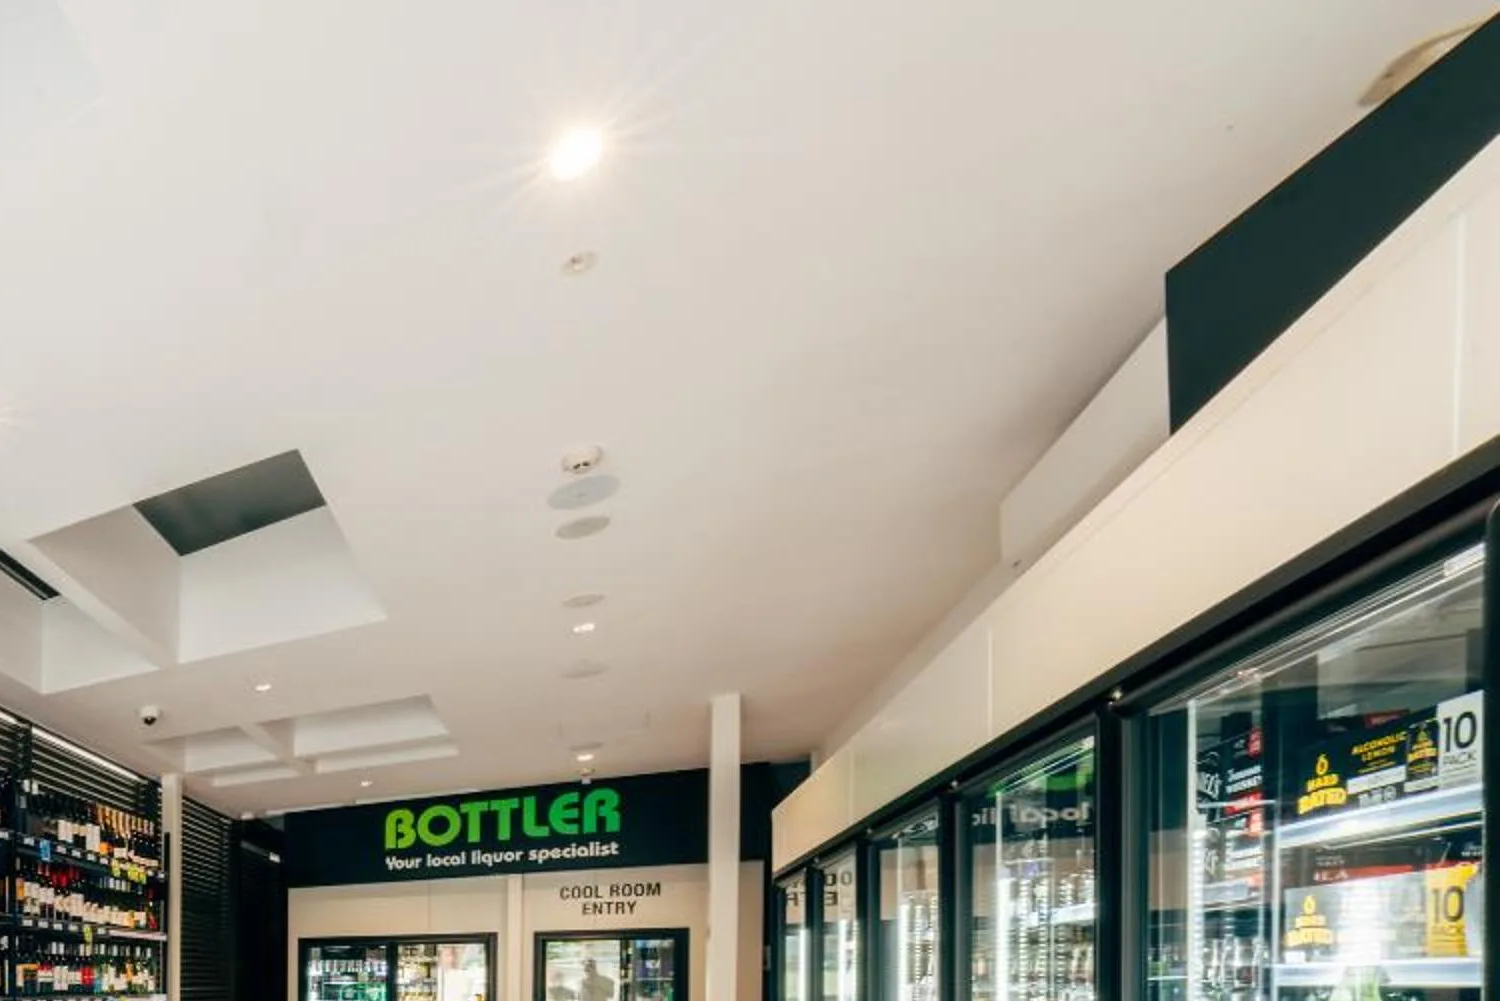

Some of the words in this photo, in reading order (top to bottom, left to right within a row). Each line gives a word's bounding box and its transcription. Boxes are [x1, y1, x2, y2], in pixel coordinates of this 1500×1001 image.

[1441, 710, 1477, 752] 10
[385, 788, 620, 849] BOTTLER
[385, 856, 422, 870] Your
[427, 851, 466, 868] local
[471, 849, 523, 867] liquor
[529, 841, 619, 864] specialist
[560, 884, 604, 900] COOL
[609, 882, 662, 898] ROOM
[1432, 886, 1464, 924] 10
[582, 900, 637, 916] ENTRY
